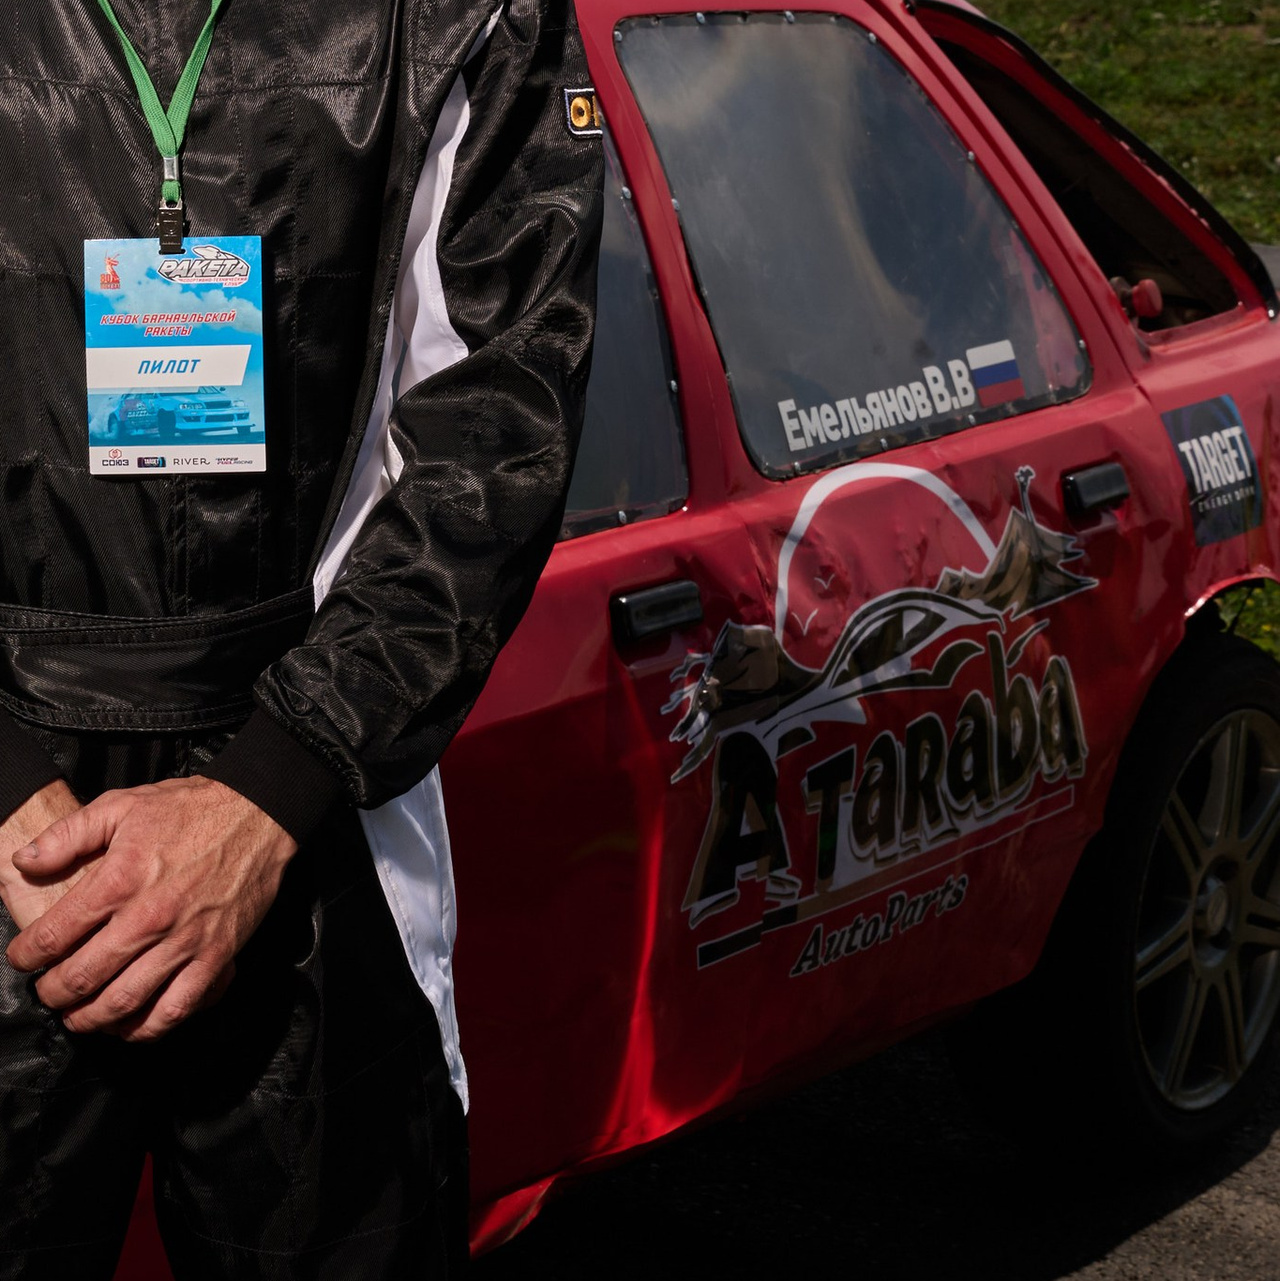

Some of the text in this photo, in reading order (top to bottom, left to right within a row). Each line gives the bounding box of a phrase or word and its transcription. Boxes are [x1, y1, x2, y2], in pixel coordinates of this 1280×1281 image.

[570, 95, 601, 128] O
[158, 259, 249, 278] РАКЕТА
[101, 311, 236, 324] КУБОК БАРНАУЛЬСКОЙ
[144, 326, 192, 337] РАКЕТЫ
[138, 359, 201, 374] ПИЛОТ
[102, 459, 129, 467] СОЮЗ
[173, 458, 211, 466] RIVER
[1177, 425, 1252, 494] TARGET
[1198, 492, 1233, 513] ENERGY
[788, 873, 970, 979] AutoParts
